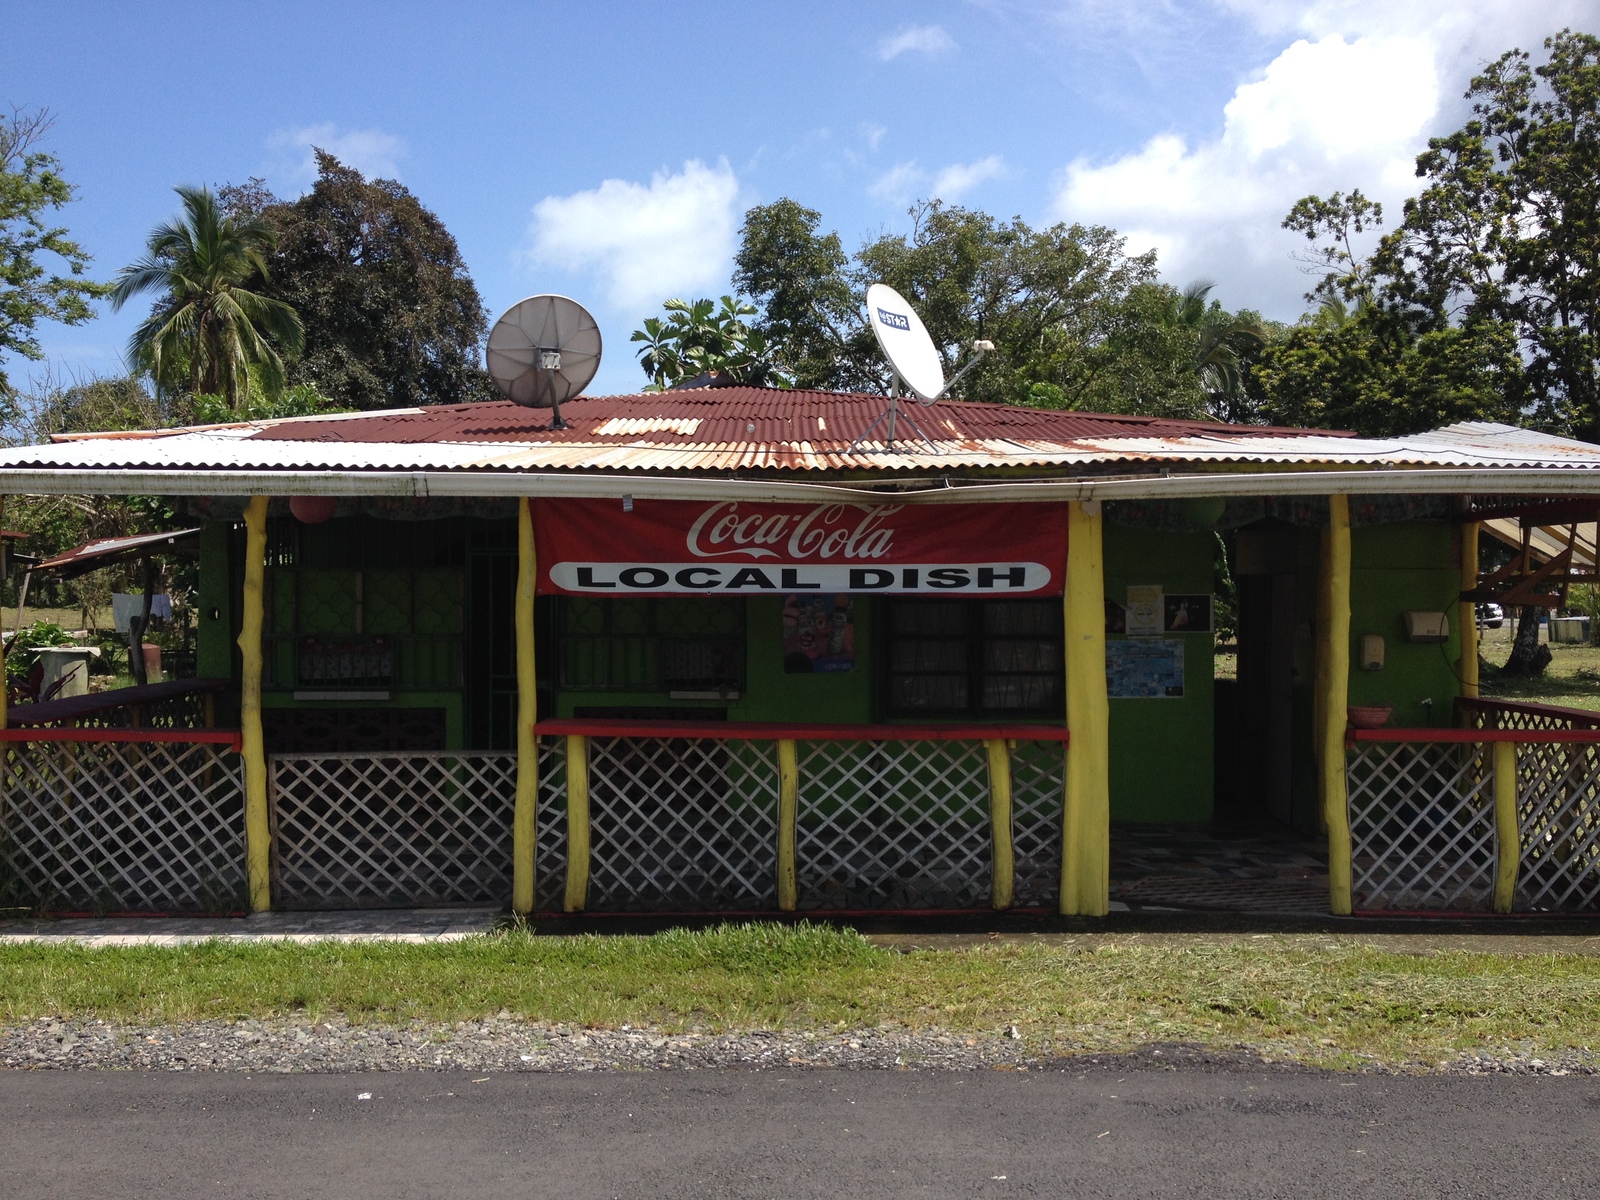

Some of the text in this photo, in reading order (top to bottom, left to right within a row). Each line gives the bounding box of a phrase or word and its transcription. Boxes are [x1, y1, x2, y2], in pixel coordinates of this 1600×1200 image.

[686, 501, 903, 559] Coca-Cola
[576, 567, 1026, 590] LOCAL DISH
